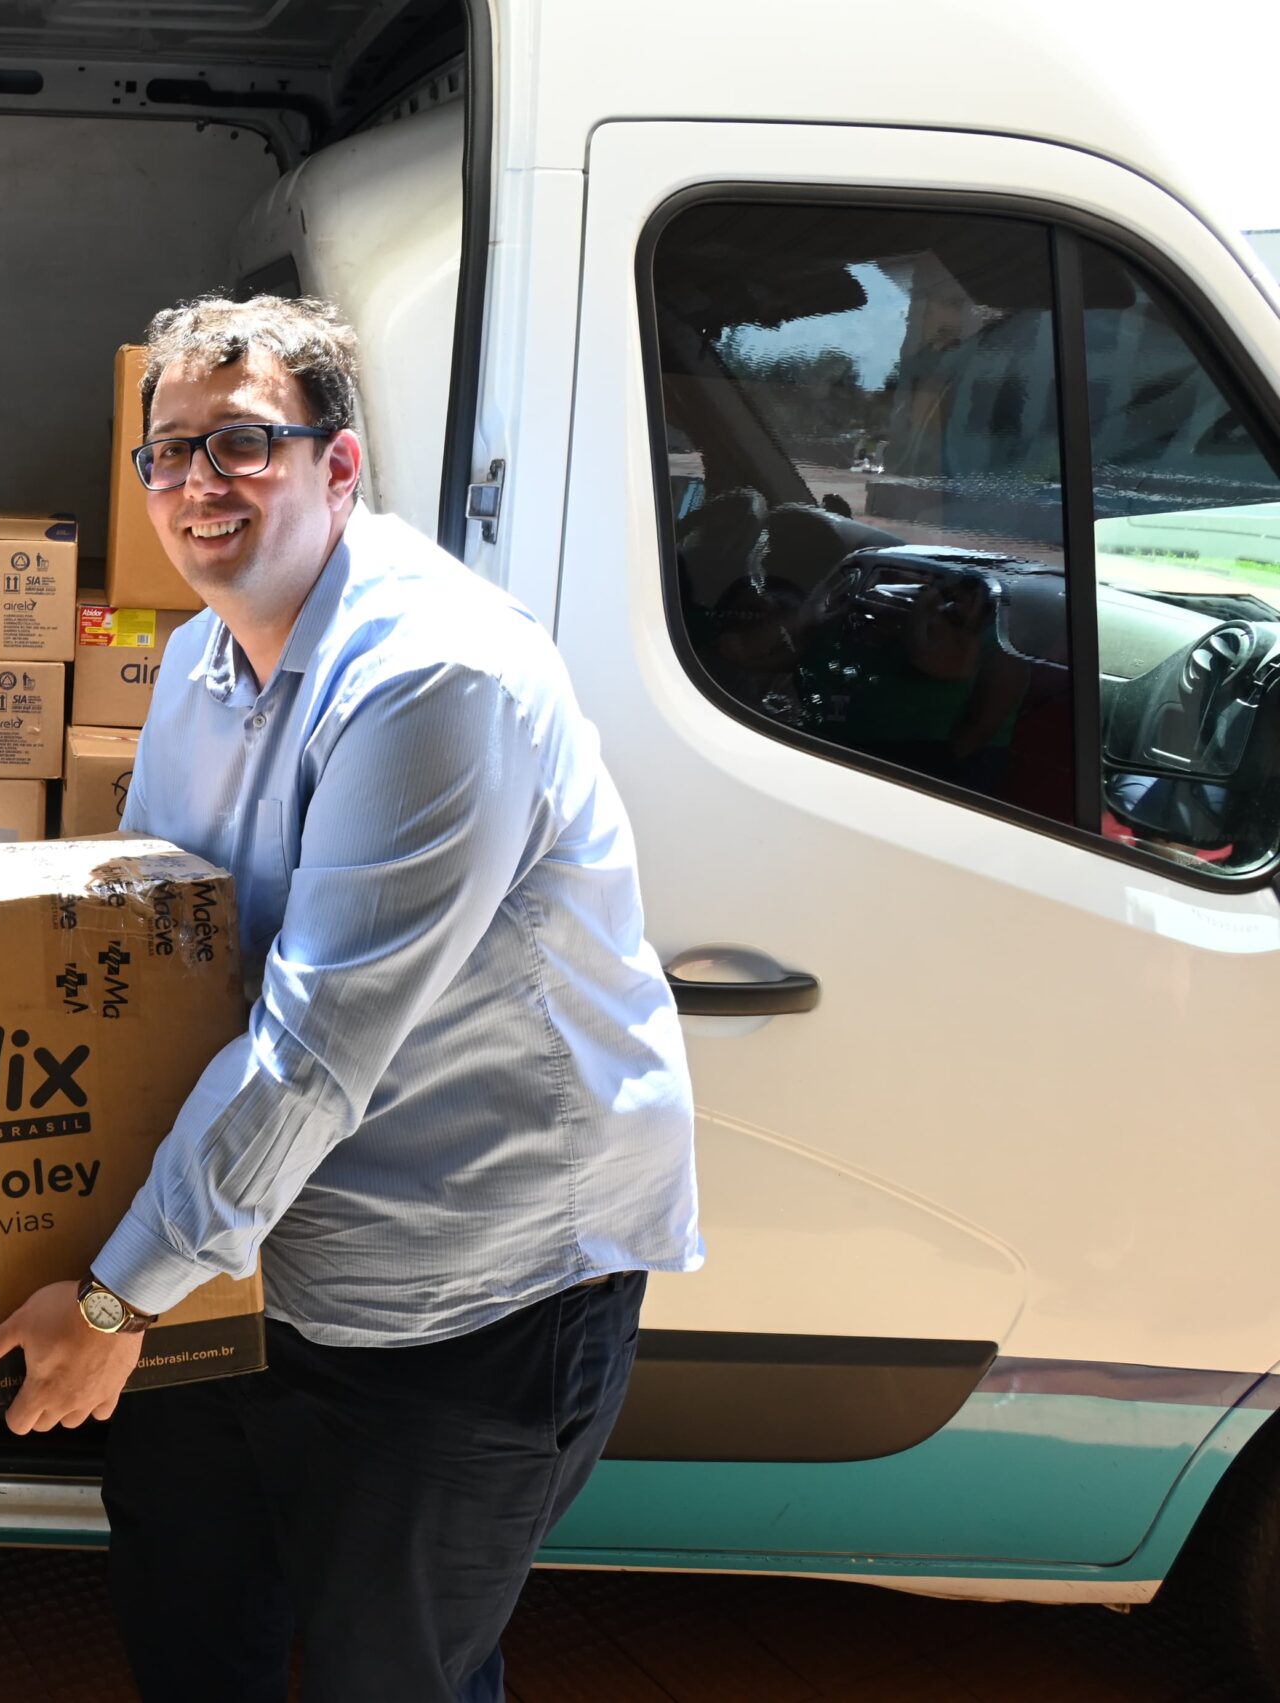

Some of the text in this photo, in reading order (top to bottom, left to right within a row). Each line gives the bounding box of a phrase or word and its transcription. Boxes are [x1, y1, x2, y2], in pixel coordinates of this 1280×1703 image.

[26, 576, 40, 585] SIA
[3, 599, 37, 611] airela
[82, 608, 102, 617] Abidor
[121, 656, 160, 684] air
[13, 695, 27, 703] SIA
[192, 882, 219, 962] Maêve
[137, 1346, 235, 1368] dixbrasil.com.br
